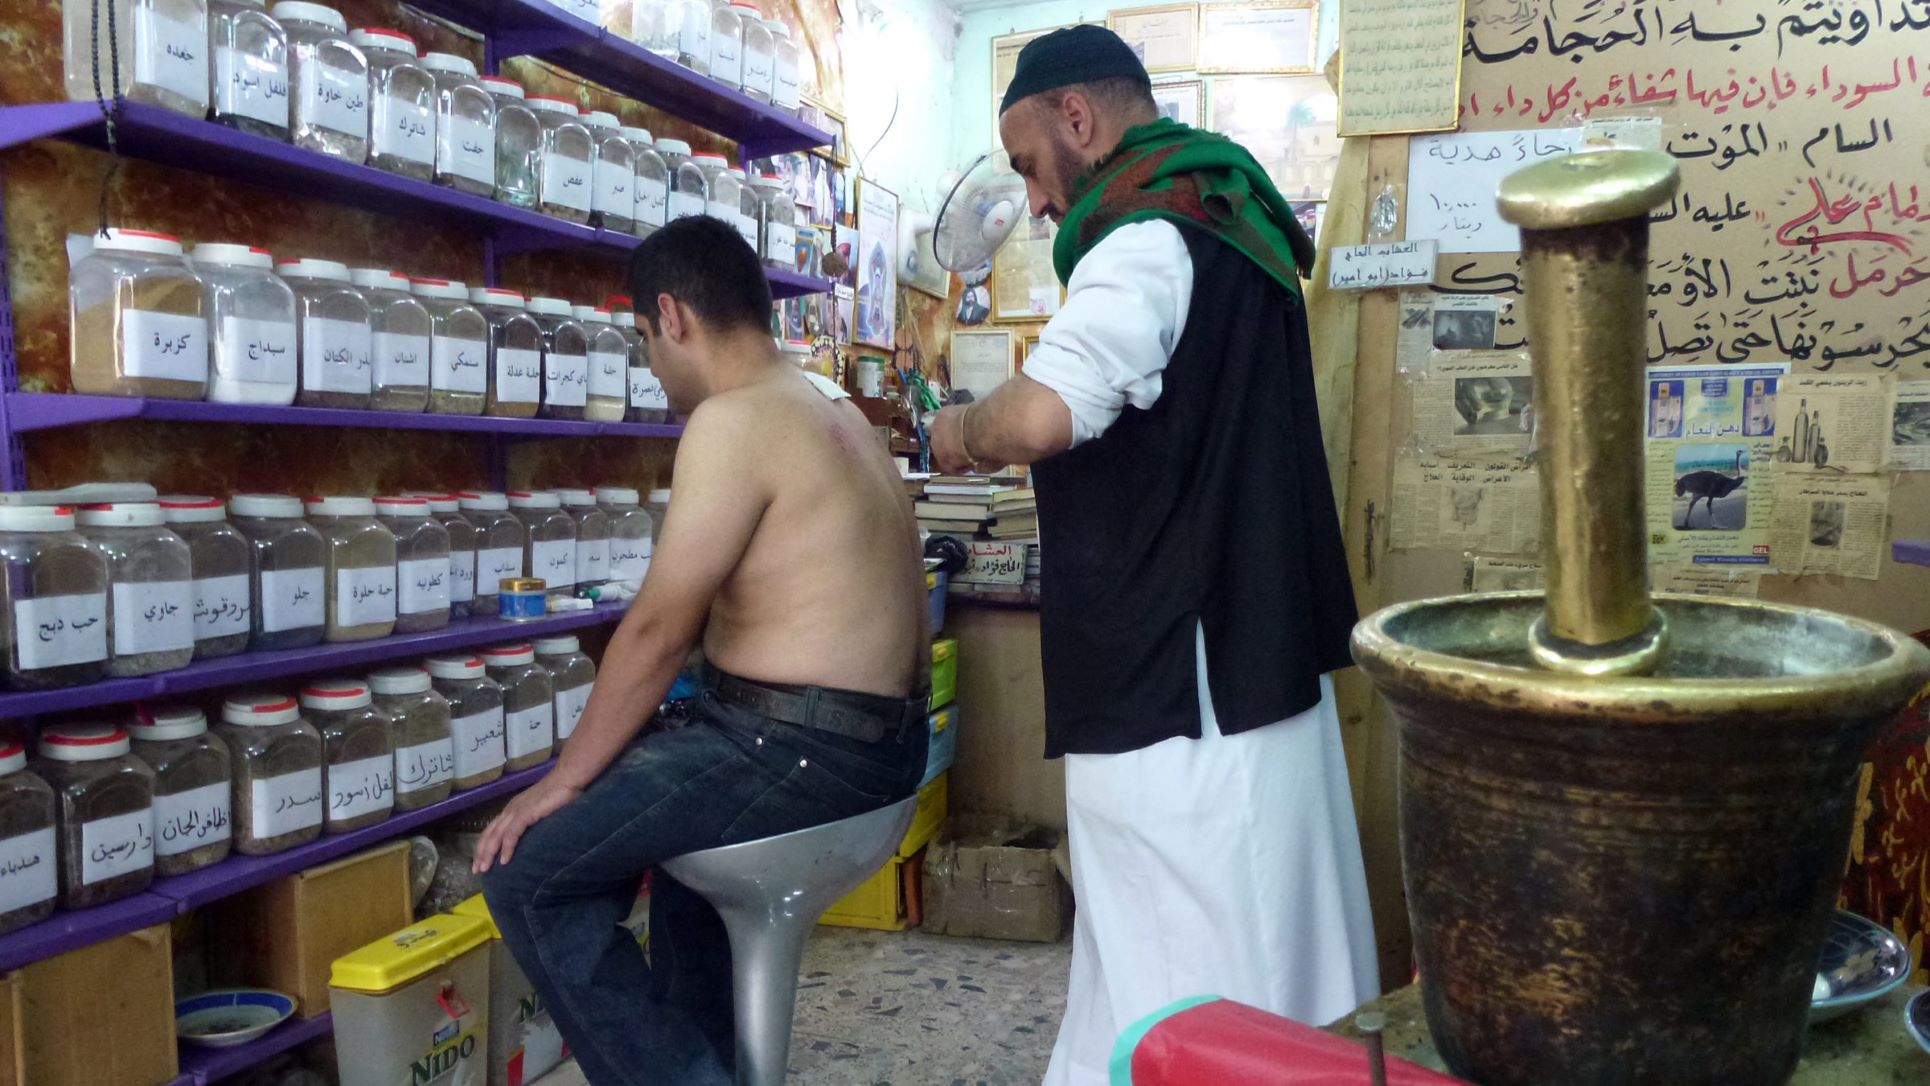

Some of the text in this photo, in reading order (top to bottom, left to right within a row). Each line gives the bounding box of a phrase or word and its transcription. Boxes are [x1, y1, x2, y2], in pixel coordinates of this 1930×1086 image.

[154, 332, 191, 355] كزبرة
[373, 771, 394, 800] لفل
[411, 1034, 475, 1086] NIDO
